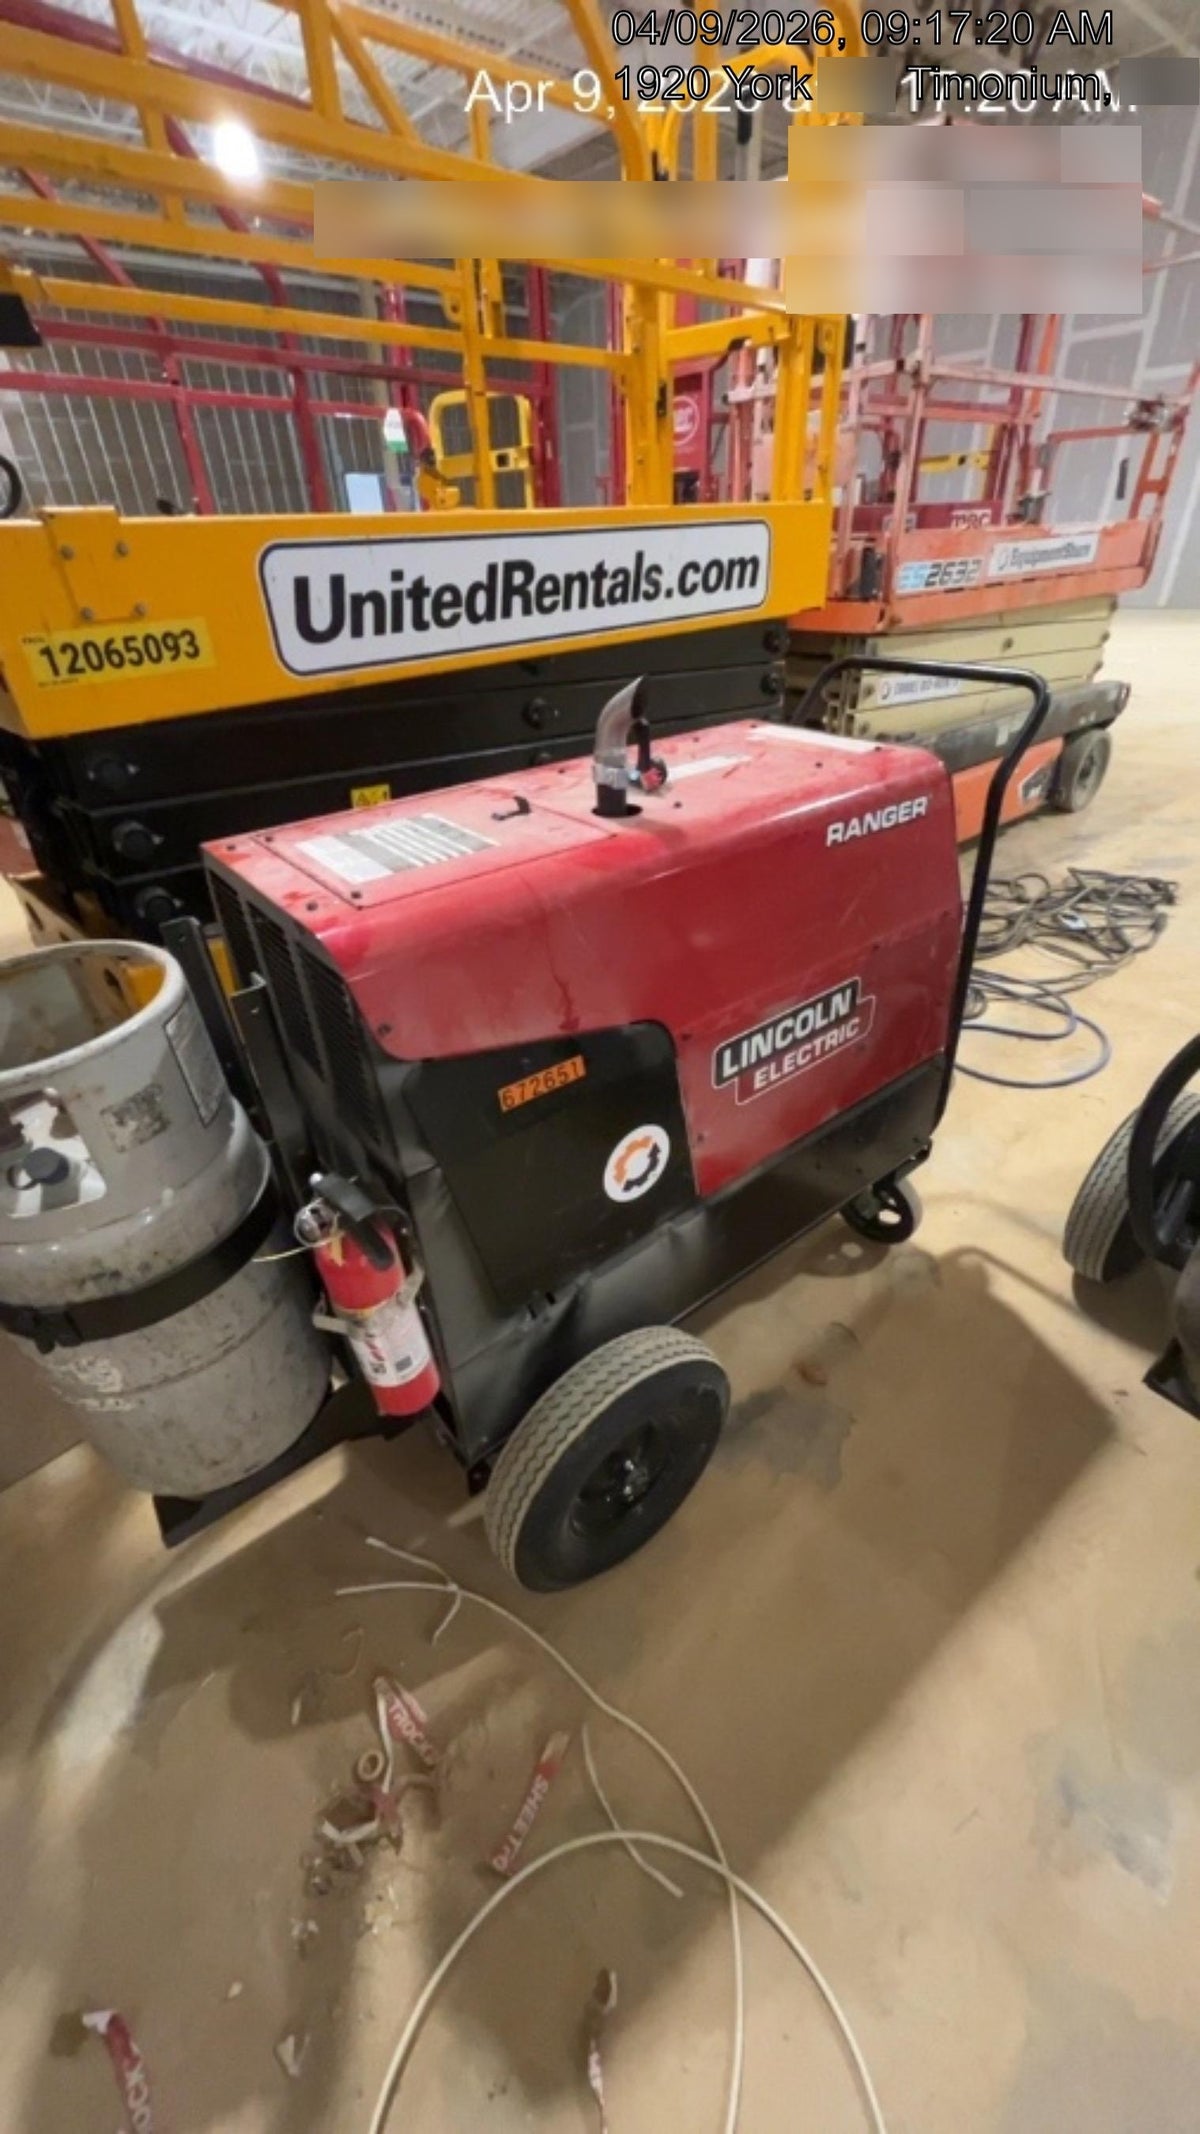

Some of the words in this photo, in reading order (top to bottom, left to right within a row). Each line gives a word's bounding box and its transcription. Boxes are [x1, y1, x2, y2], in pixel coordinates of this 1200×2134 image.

[293, 550, 761, 645] UnitedRentals.com
[39, 629, 201, 678] 12065093
[826, 796, 929, 847] RANGER
[721, 987, 852, 1078] LINCOLN
[753, 1016, 861, 1091] ELECTRIC
